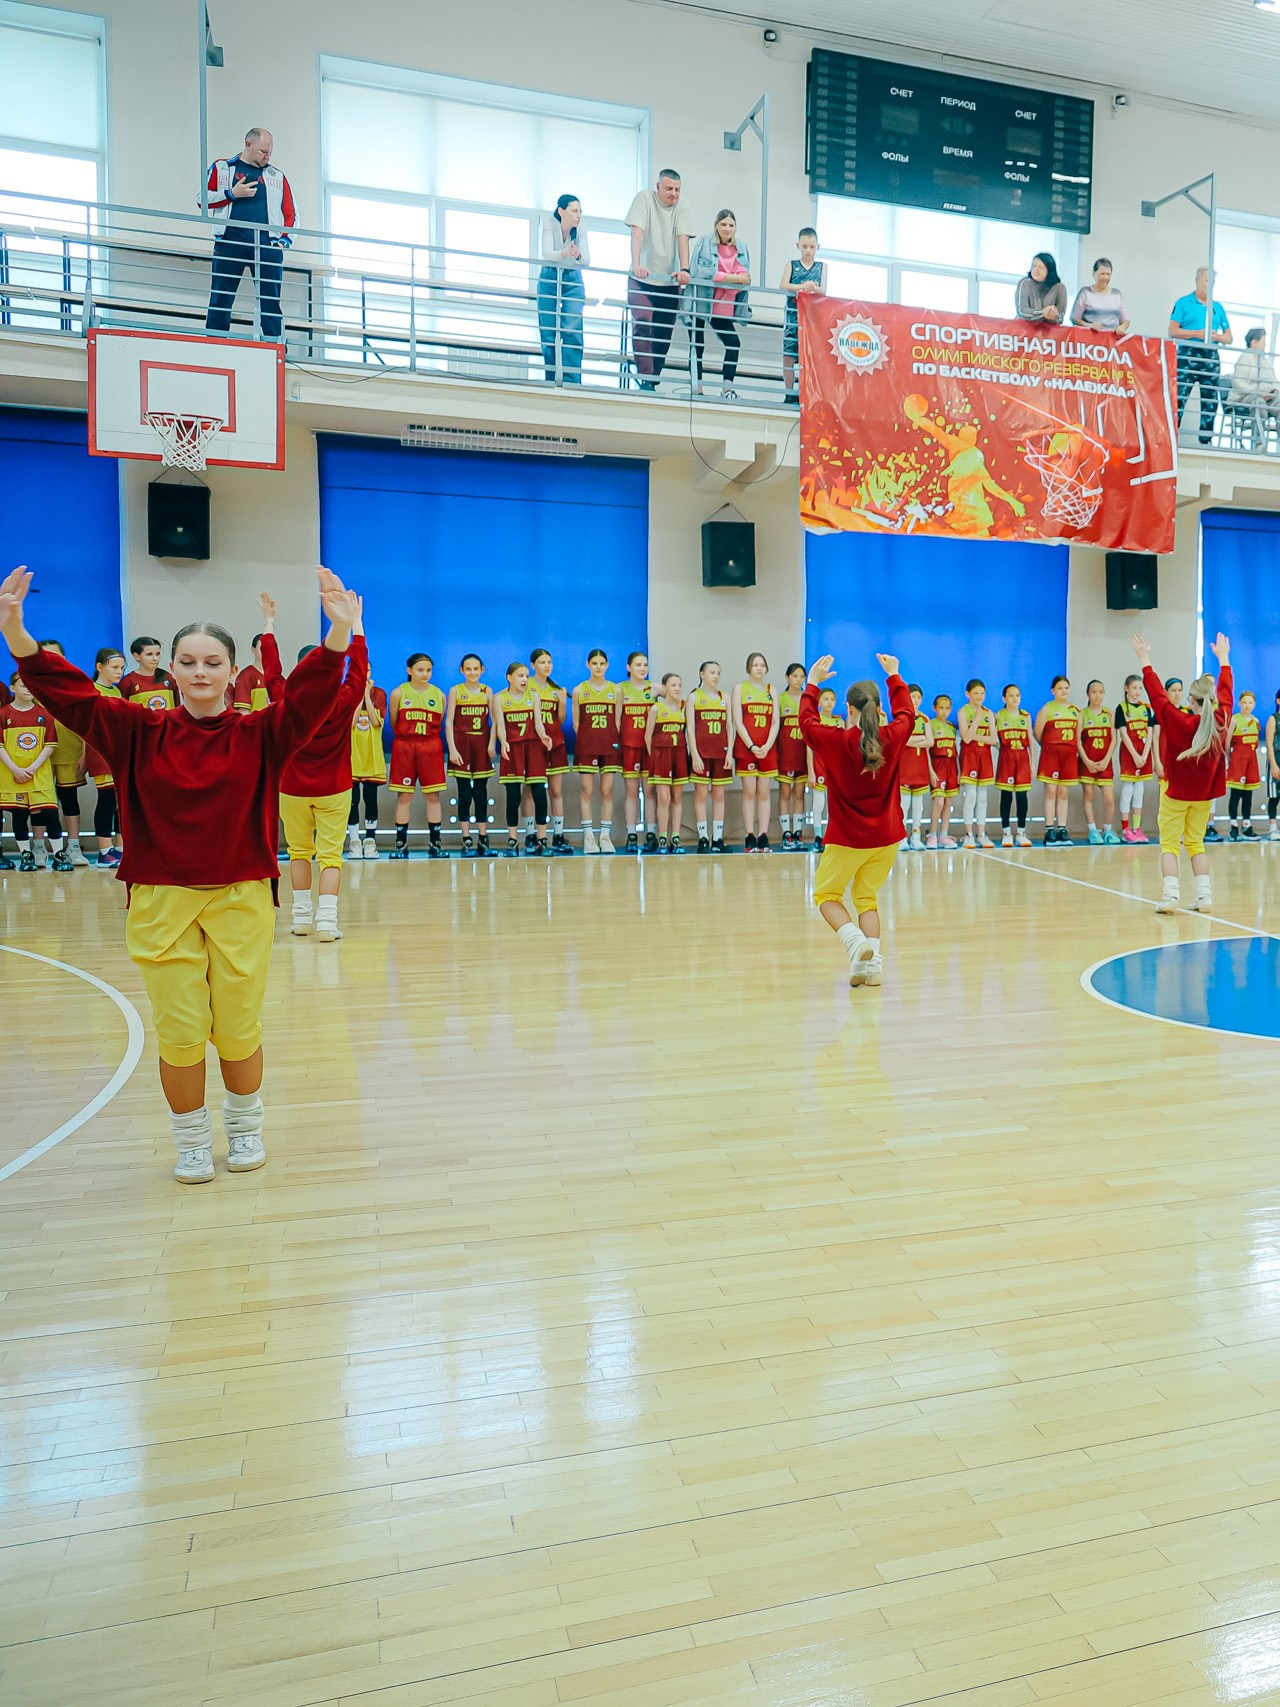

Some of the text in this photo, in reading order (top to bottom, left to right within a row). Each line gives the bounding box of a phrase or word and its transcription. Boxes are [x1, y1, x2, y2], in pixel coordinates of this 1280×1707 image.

[890, 87, 914, 98] СЧЕТ
[940, 96, 977, 111] ПЕРИОД
[1015, 109, 1037, 120] СЧЕТ
[881, 151, 909, 163] ФОЛЫ
[942, 146, 974, 158] ВРЕМЯ
[1004, 171, 1030, 182] ФОЛЫ
[910, 323, 1057, 357] СПОРТИВНАЯ
[1060, 341, 1133, 368] ШКОЛА
[912, 345, 1040, 374] ОЛИМПИЙСКОГО
[1043, 361, 1109, 380] РЕЗЕРВА
[1126, 371, 1135, 385] 5
[912, 362, 1136, 398] ПО БАСКЕТБОЛУ «НАДЕЖДА»
[415, 722, 427, 735] 41
[472, 717, 482, 730] 3
[591, 715, 608, 729] 25
[632, 716, 645, 729] 75
[707, 721, 722, 735] 10
[518, 723, 527, 736] 7
[671, 733, 678, 746] 1
